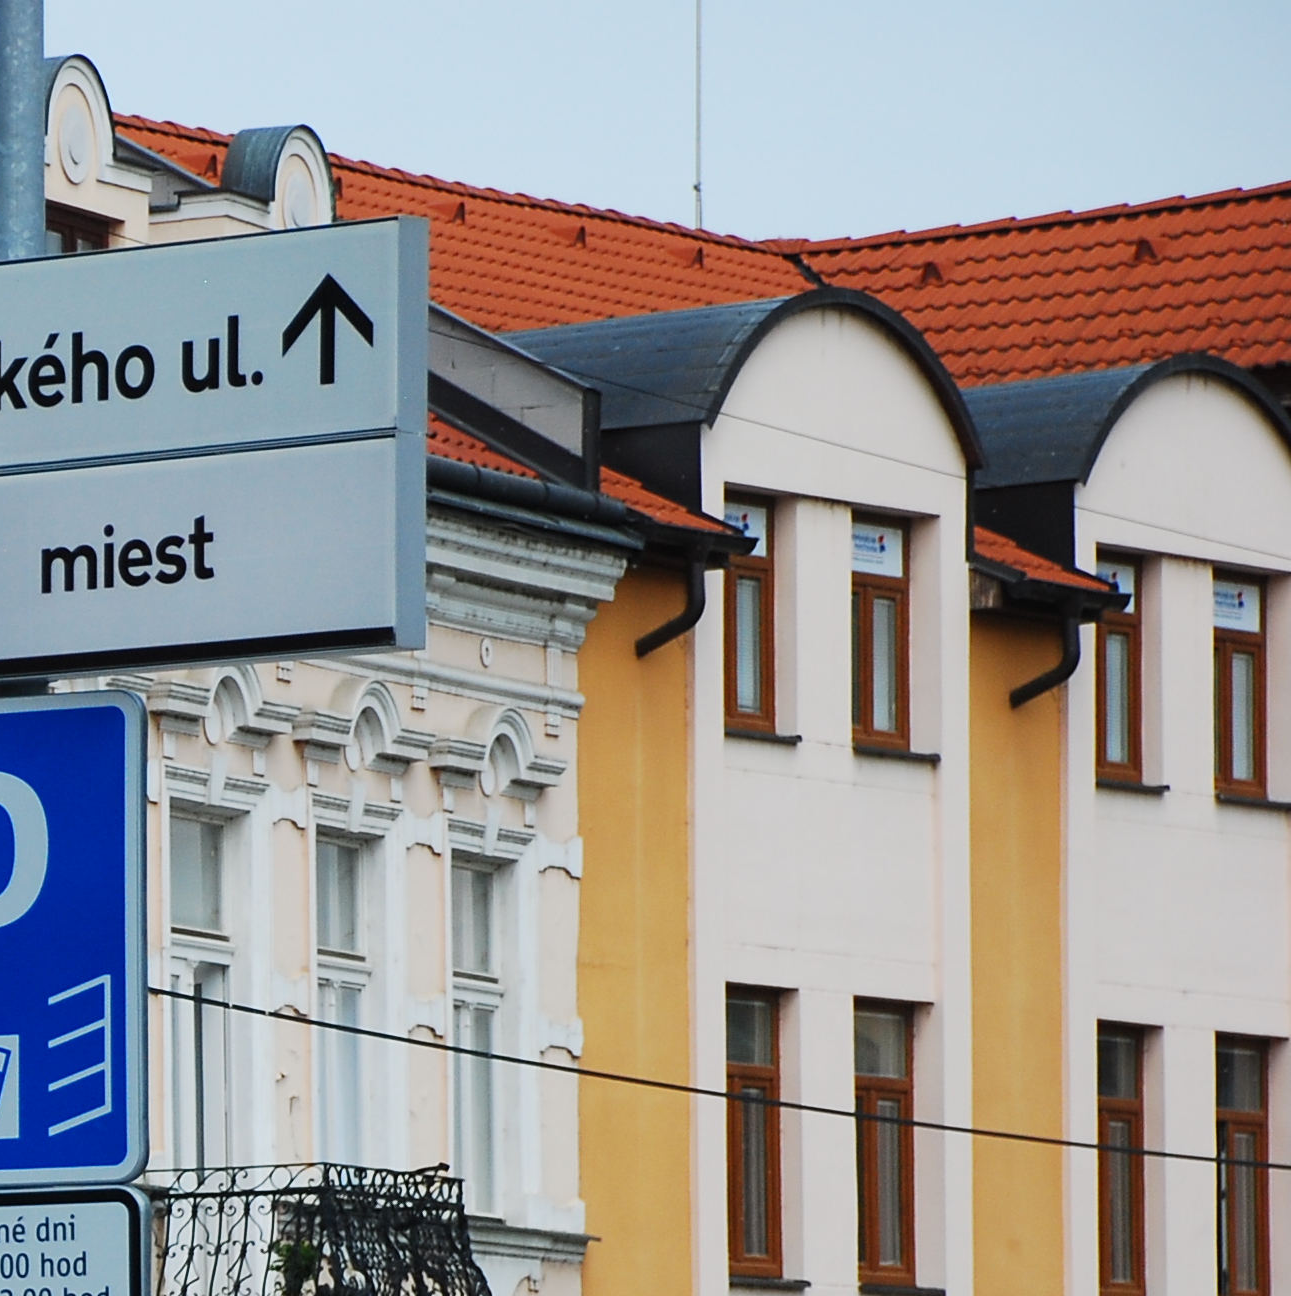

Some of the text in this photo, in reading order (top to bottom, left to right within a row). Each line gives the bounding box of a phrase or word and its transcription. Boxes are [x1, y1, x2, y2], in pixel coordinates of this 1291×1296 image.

[182, 315, 264, 392] ul.
[41, 515, 215, 594] miest
[35, 1214, 76, 1242] dni
[40, 1251, 87, 1278] hod
